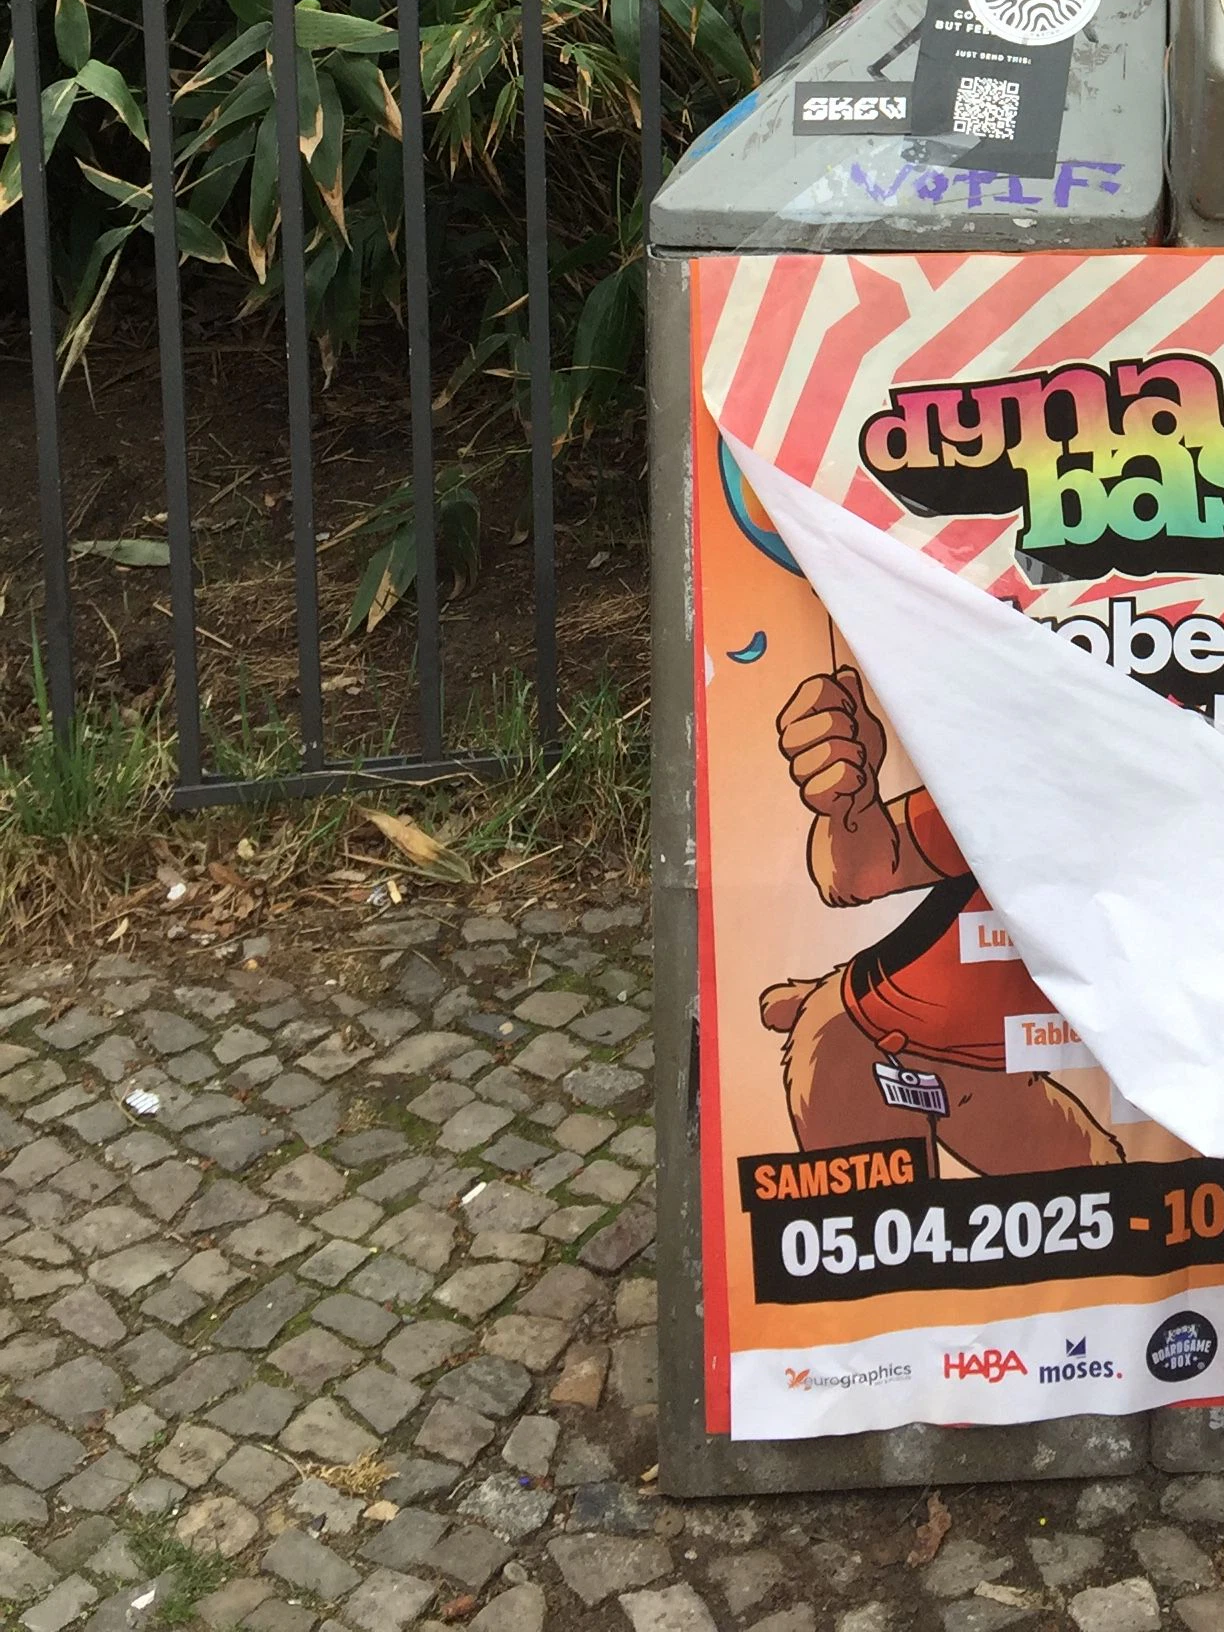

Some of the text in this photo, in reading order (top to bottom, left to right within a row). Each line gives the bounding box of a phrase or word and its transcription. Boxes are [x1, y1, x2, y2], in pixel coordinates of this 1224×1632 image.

[935, 20, 962, 31] BUT
[953, 9, 978, 20] GO
[956, 50, 978, 59] JUST
[979, 53, 1005, 62] SEND
[755, 1149, 913, 1201] SAMSTAG
[781, 1192, 1114, 1277] 05.04.2025
[1151, 1338, 1213, 1365] BOARDGAME
[803, 1362, 912, 1391] eurographics
[943, 1349, 1028, 1384] HABA
